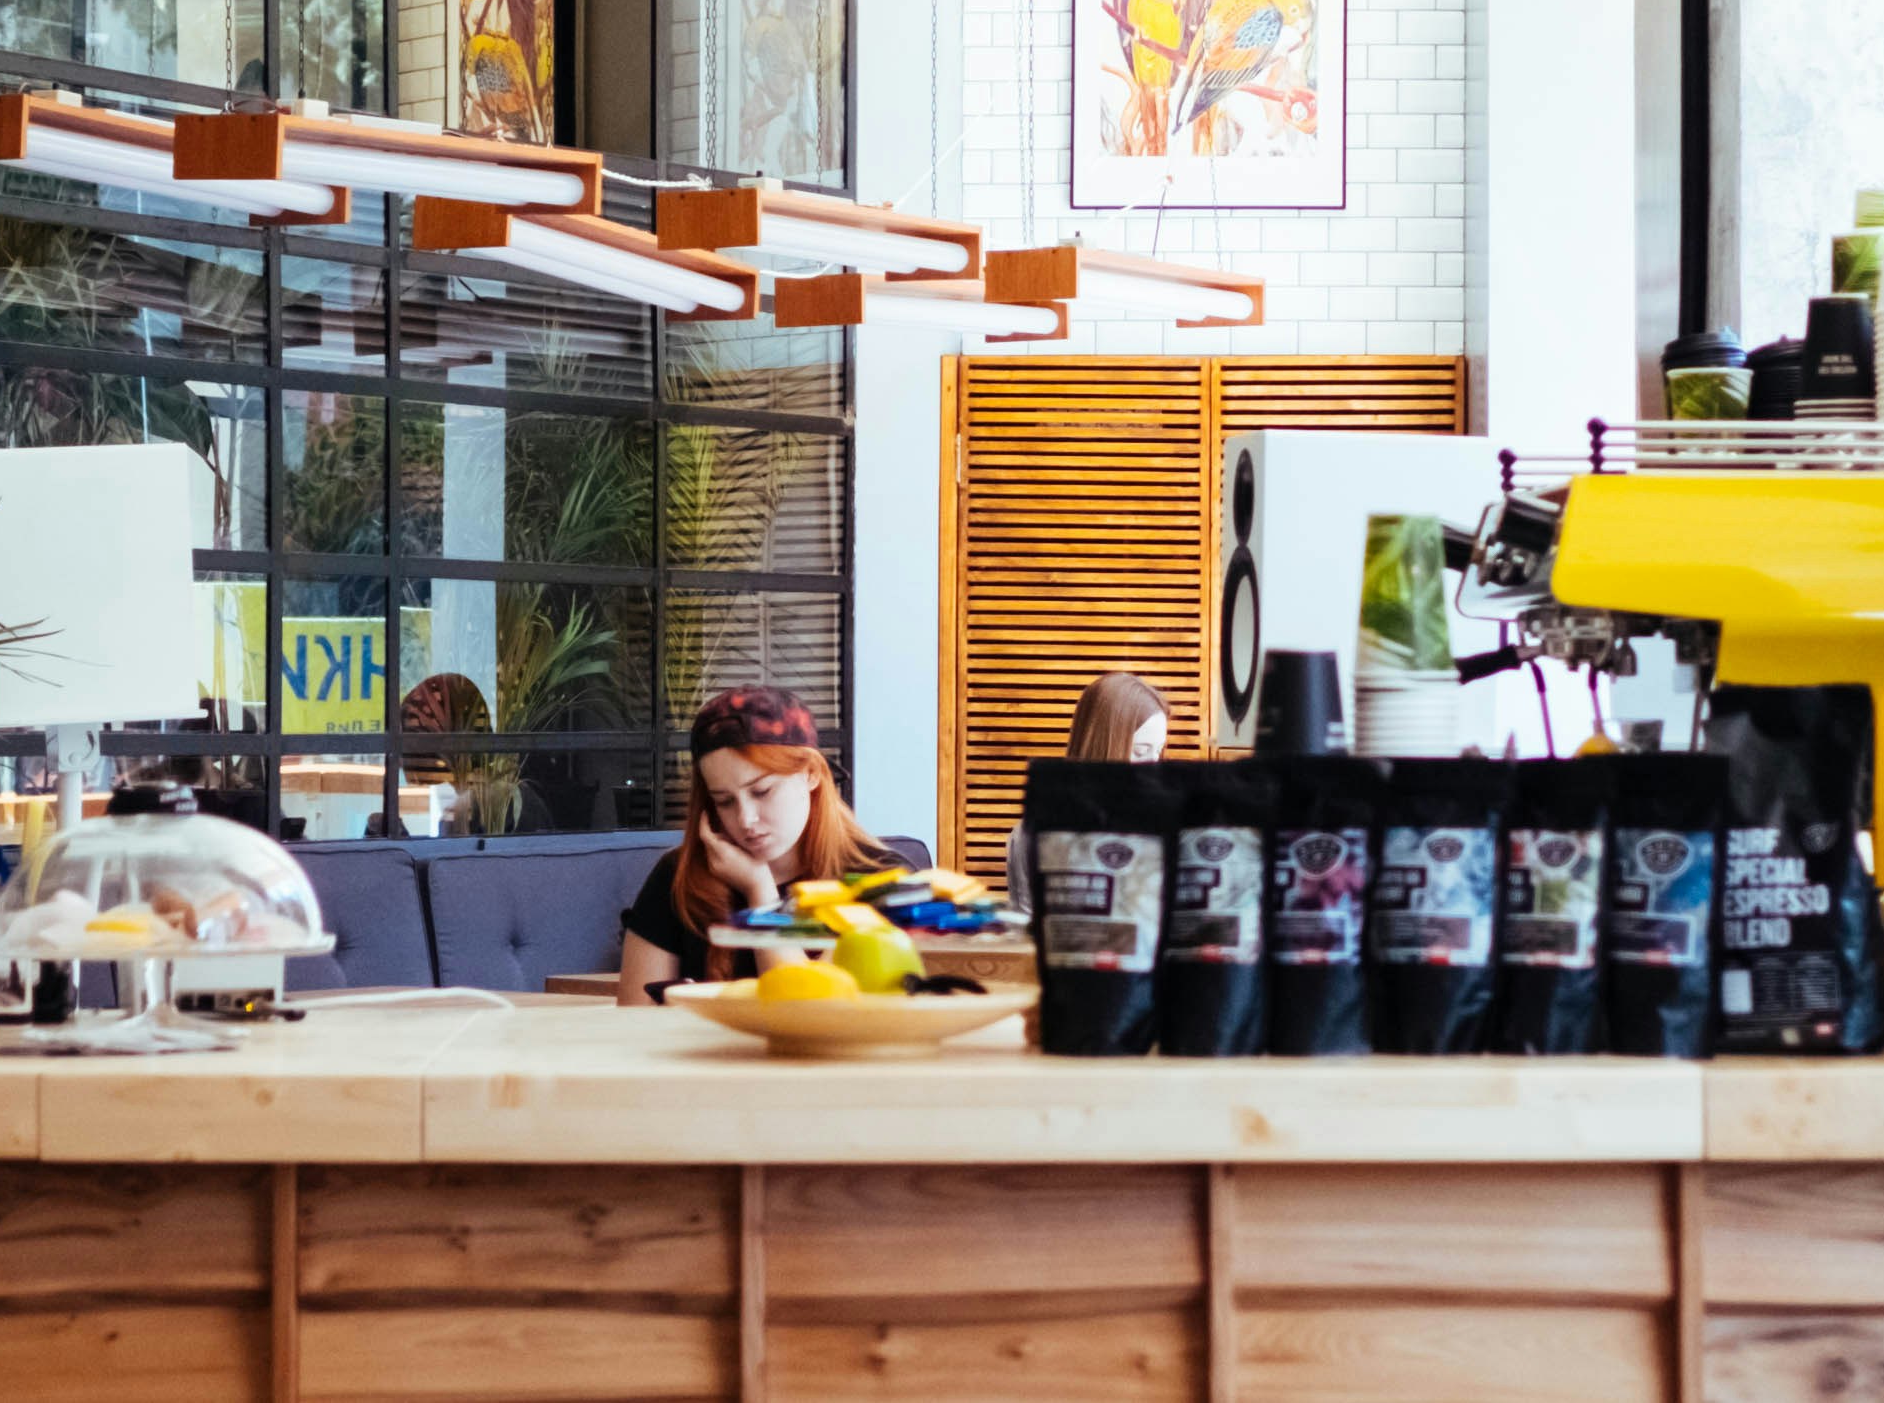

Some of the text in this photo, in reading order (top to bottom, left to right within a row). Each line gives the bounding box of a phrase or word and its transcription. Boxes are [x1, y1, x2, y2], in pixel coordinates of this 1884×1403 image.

[1727, 827, 1781, 855] SURF
[1725, 857, 1809, 886] SPECIAL
[1723, 884, 1829, 917] ESPRESSO
